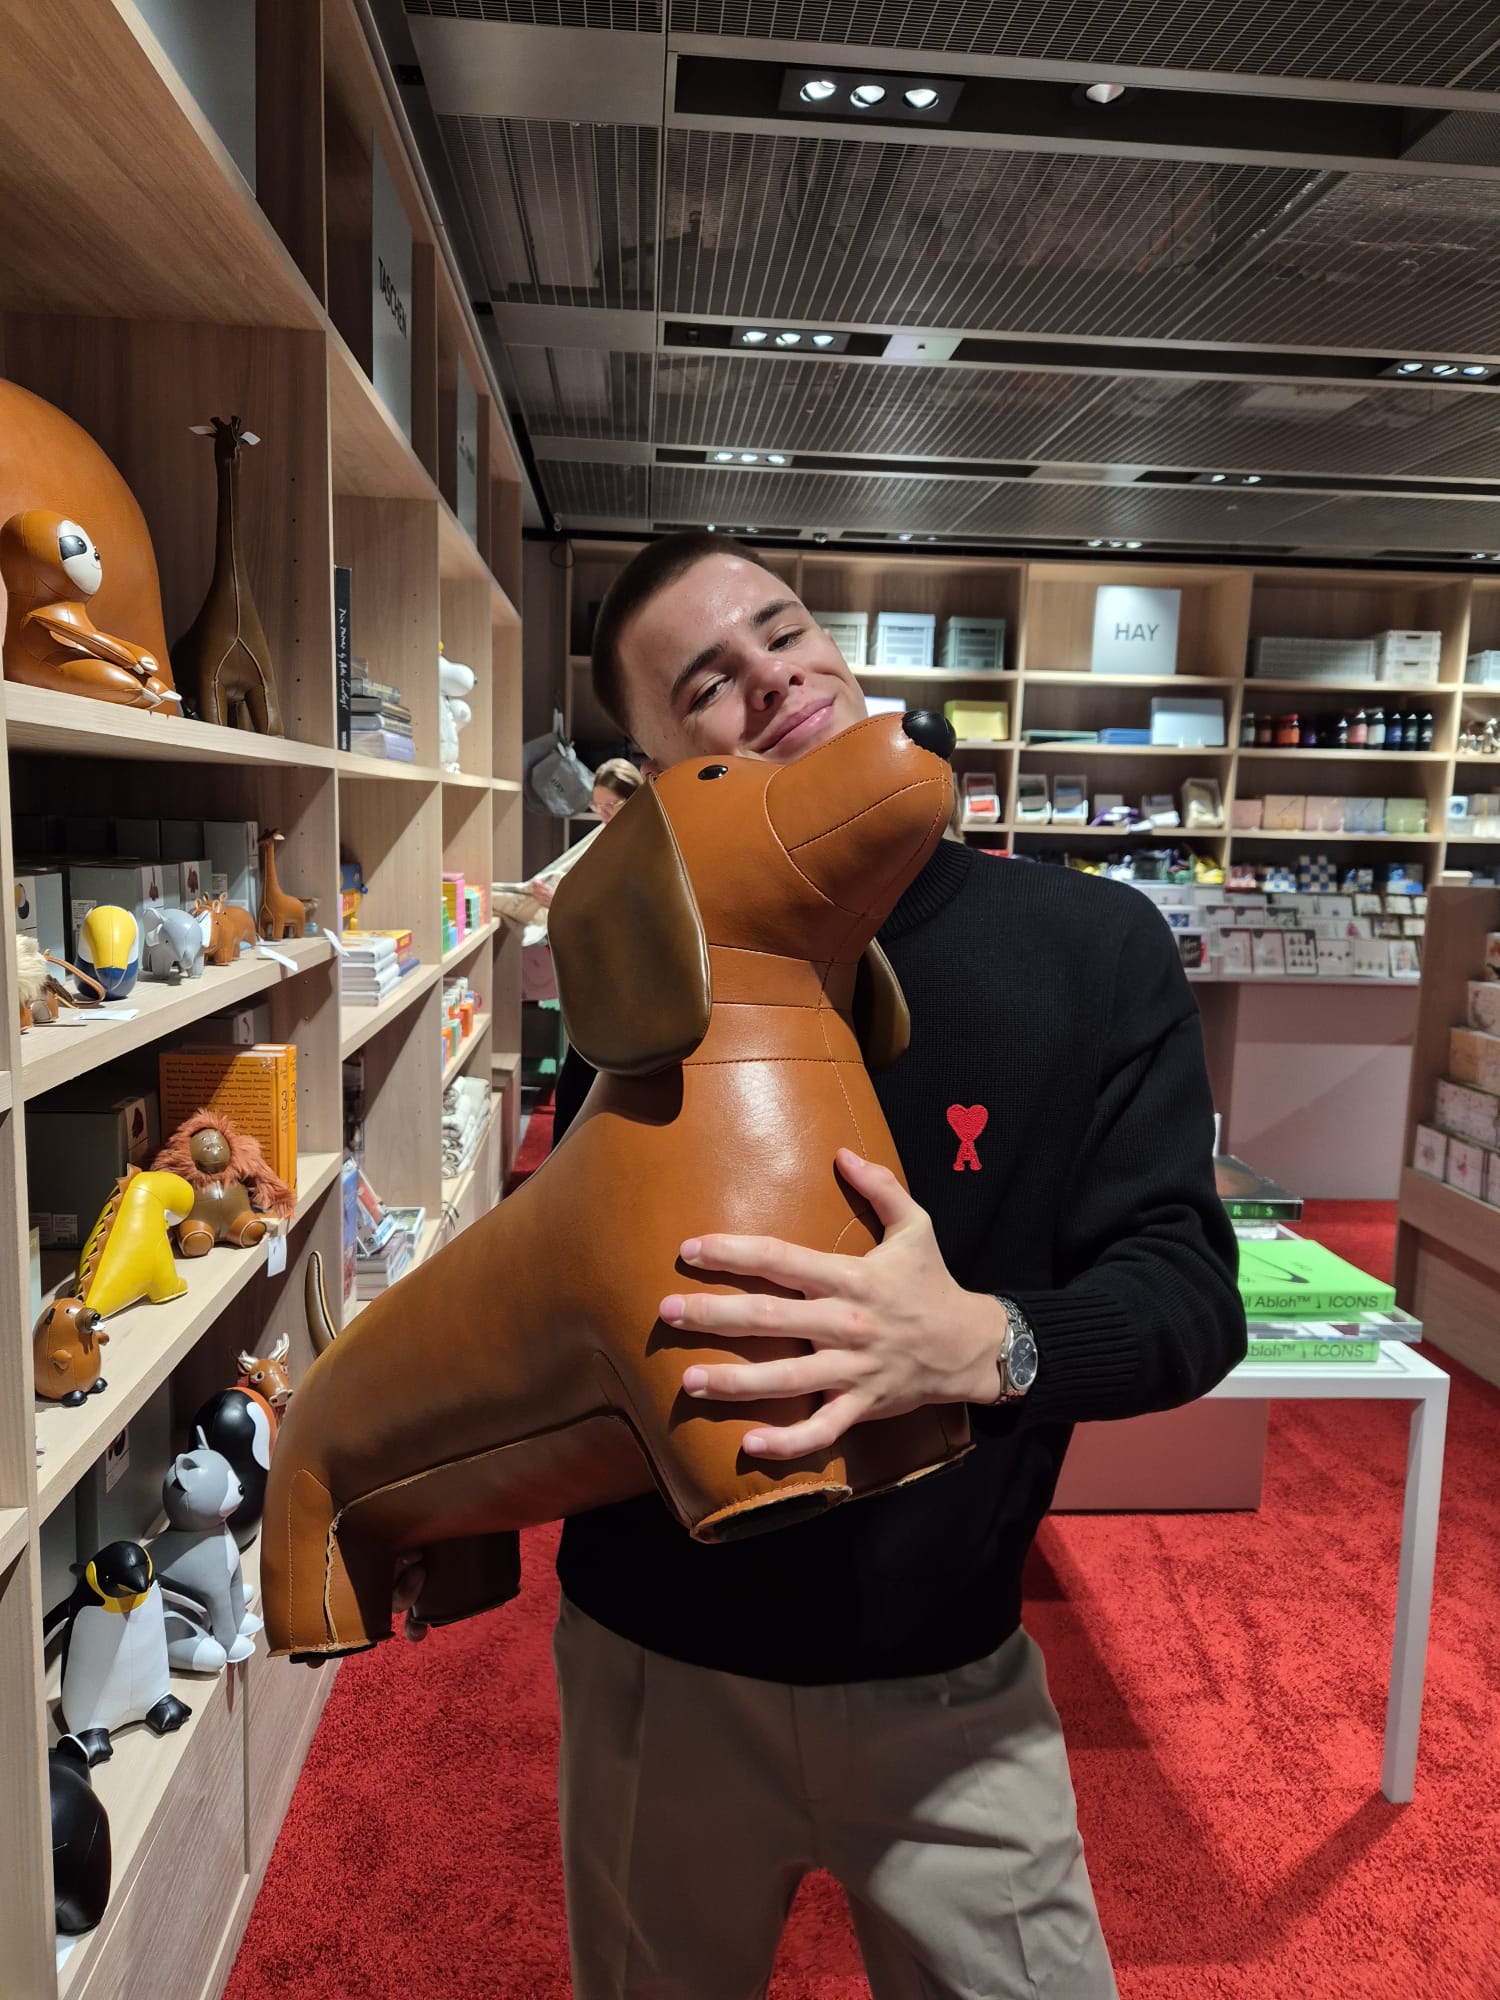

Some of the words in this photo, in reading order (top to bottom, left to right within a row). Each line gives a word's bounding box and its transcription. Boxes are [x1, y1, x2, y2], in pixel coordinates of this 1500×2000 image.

[378, 257, 408, 340] TASCHEN
[1114, 623, 1160, 641] HAY
[281, 1090, 288, 1111] 3
[1328, 1295, 1379, 1309] ICONS
[1313, 1343, 1364, 1358] ICONS
